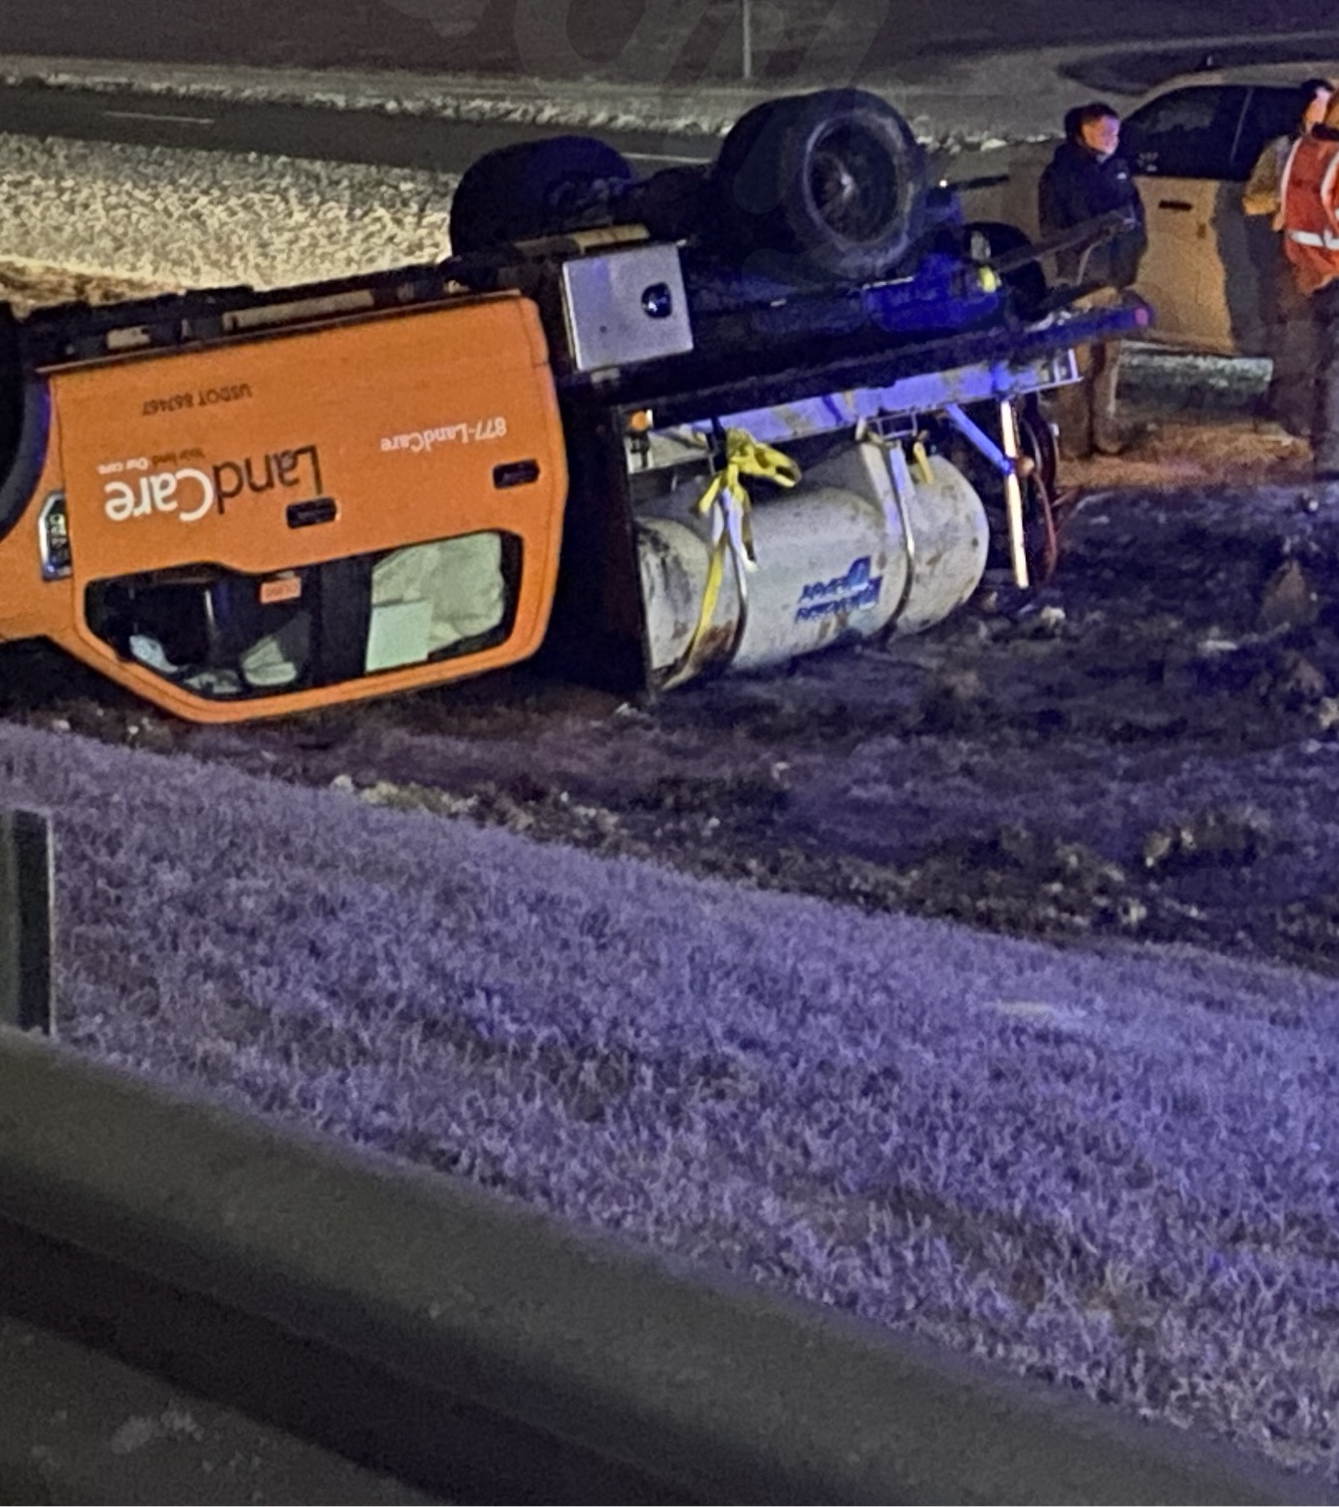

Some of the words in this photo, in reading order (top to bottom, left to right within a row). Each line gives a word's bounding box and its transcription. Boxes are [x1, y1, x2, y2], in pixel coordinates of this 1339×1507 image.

[198, 383, 253, 408] USDOT
[380, 416, 507, 453] 877-LandCare
[104, 445, 322, 522] LandCare
